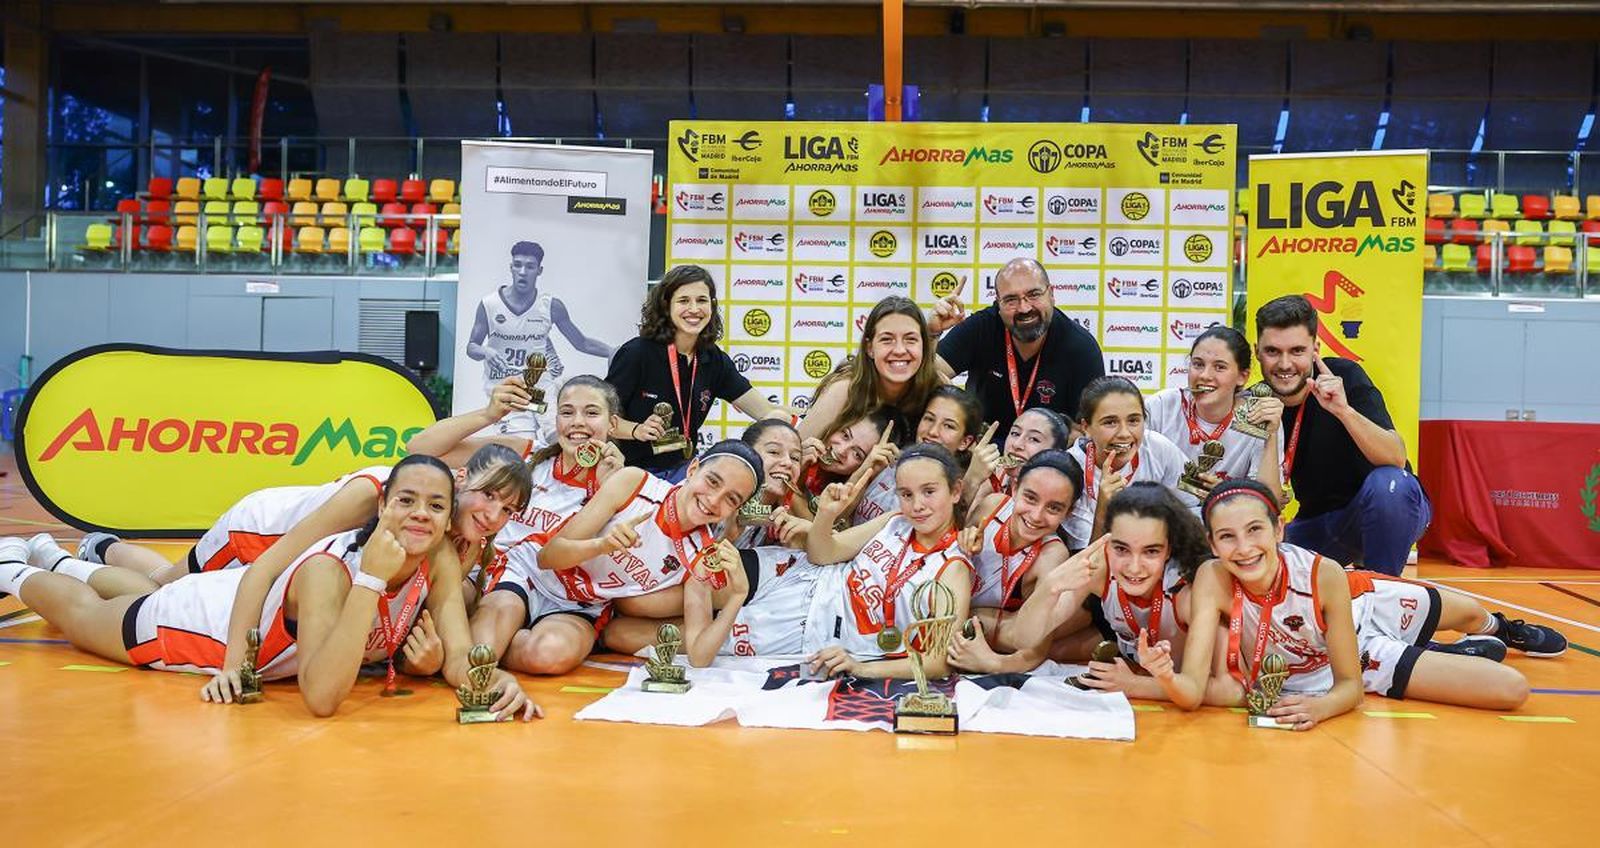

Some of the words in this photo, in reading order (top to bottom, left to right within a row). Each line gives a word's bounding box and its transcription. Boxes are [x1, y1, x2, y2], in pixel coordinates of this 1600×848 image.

[701, 134, 726, 144] FBM
[1162, 137, 1188, 148] FBM
[784, 136, 845, 160] LIGA
[1064, 144, 1107, 159] COPA
[493, 175, 597, 190] #AlimentandoElFuturo
[864, 193, 897, 207] LIGA
[1068, 198, 1093, 207] COPA
[1257, 181, 1386, 229] LIGA
[1391, 217, 1416, 227] FBM
[925, 235, 958, 248] LIGA
[1130, 240, 1155, 248] COPA
[1193, 281, 1217, 290] COPA
[505, 348, 526, 366] 29
[752, 356, 776, 365] COPA
[1110, 360, 1144, 373] LIGA
[598, 572, 626, 589] 7
[1255, 622, 1266, 662] BALONCESTO
